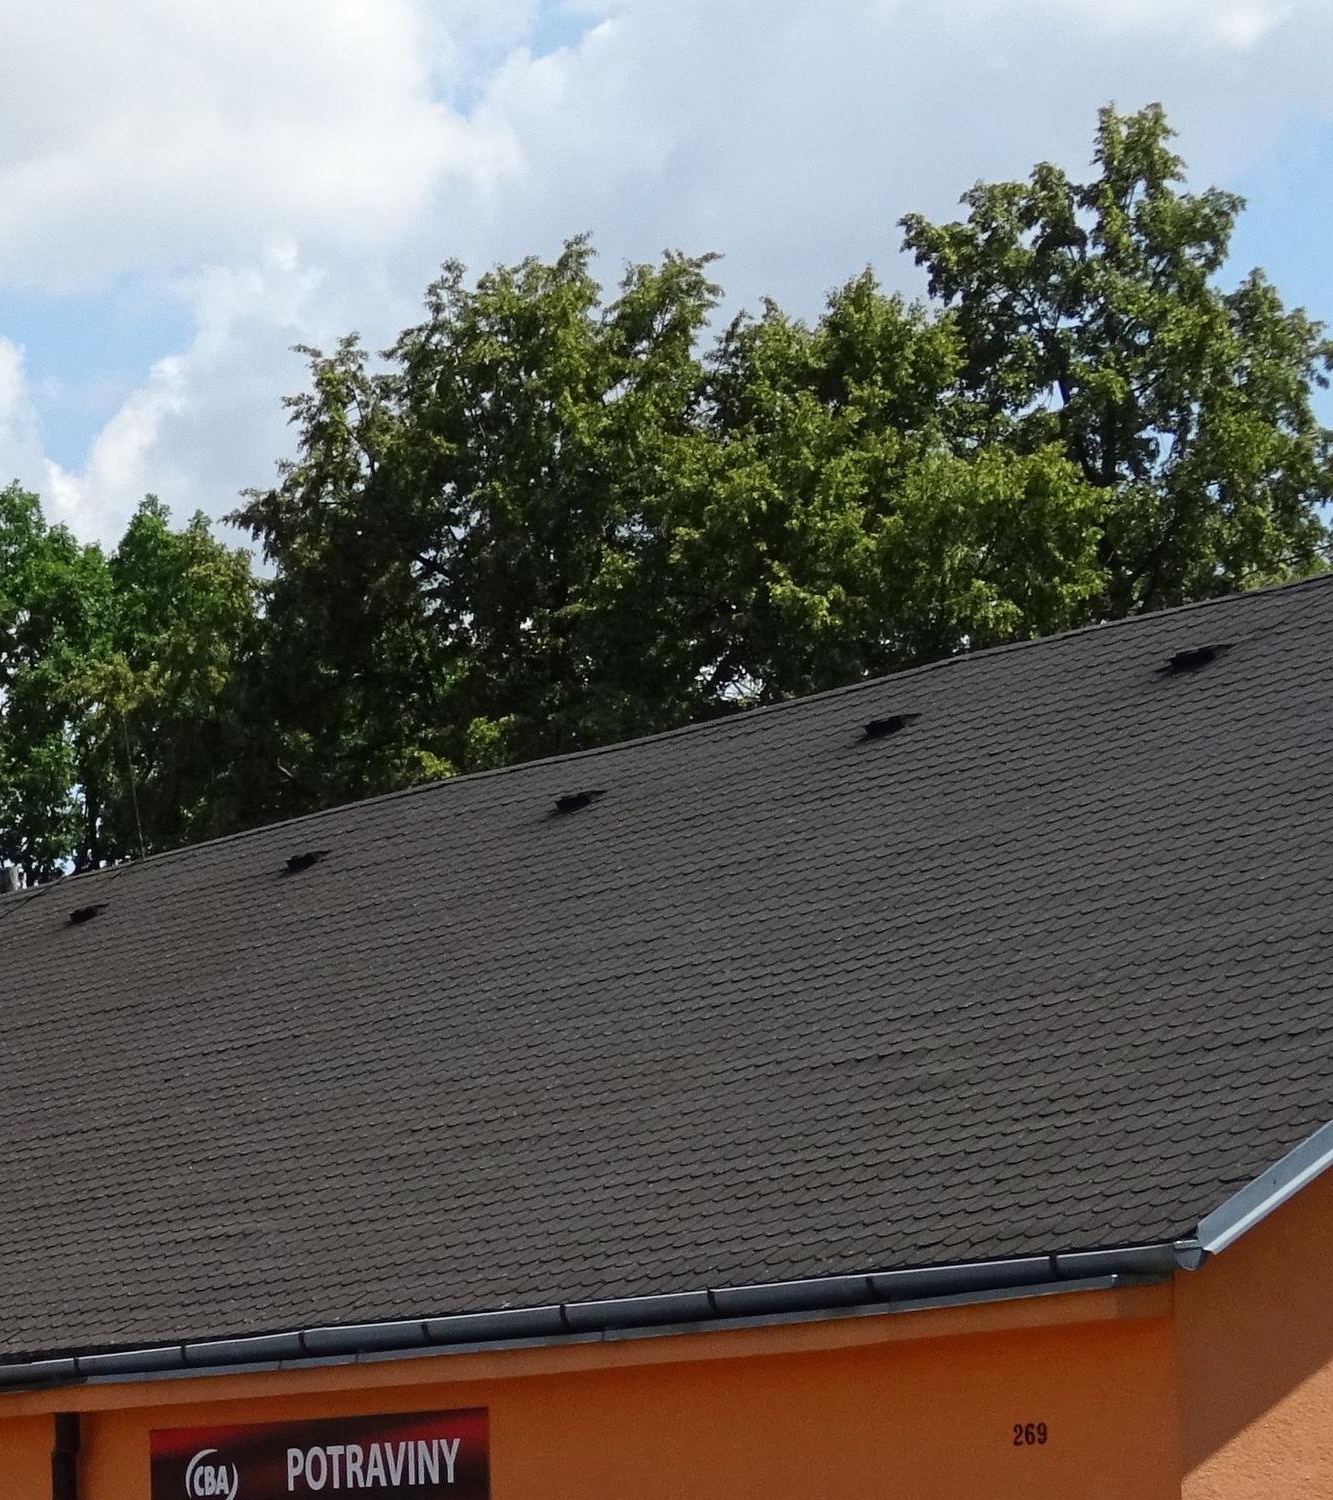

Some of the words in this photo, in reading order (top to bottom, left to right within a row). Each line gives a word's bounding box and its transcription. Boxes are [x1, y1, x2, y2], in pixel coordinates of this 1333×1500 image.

[1013, 1422, 1048, 1446] 269
[287, 1438, 460, 1491] POTRAVINY
[193, 1465, 229, 1496] CBA
